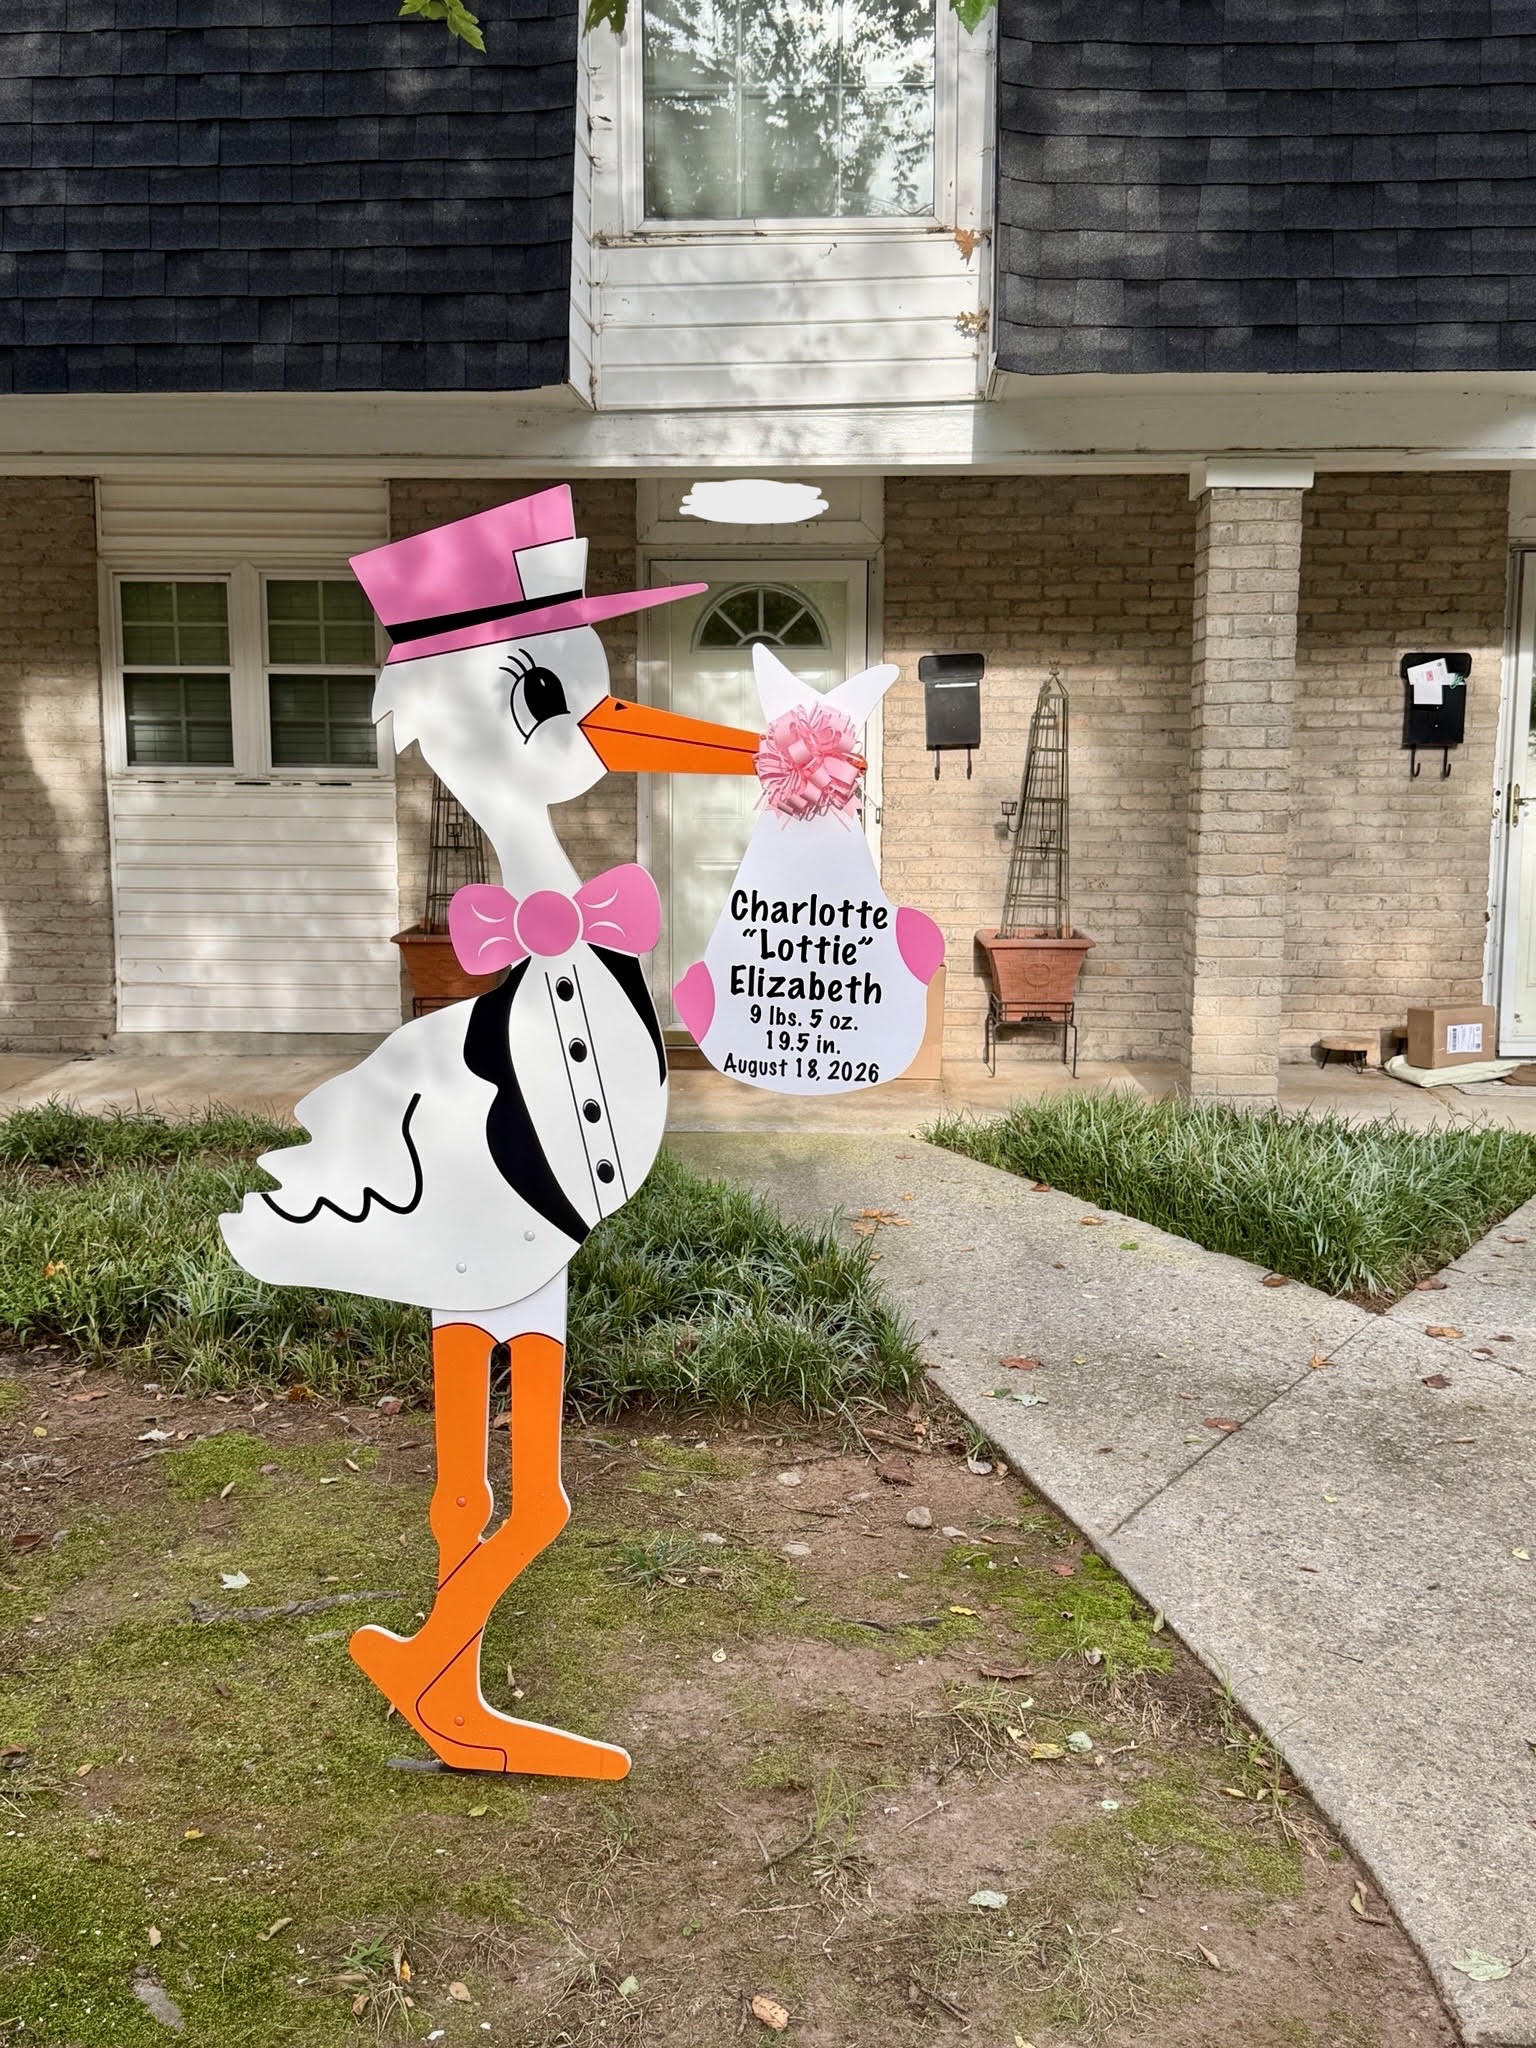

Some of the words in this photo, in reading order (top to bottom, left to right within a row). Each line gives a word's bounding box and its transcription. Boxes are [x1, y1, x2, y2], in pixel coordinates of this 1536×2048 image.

[730, 889, 888, 930] Charlotte
[730, 964, 882, 1005] Elizabeth
[749, 1003, 762, 1024] 9
[769, 1005, 802, 1027] lbs.
[809, 1008, 824, 1029] 5
[829, 1014, 858, 1031] oz.
[766, 1029, 811, 1053] 19.5
[816, 1034, 841, 1055] in.
[723, 1052, 789, 1079] August
[795, 1057, 821, 1082] 18,
[827, 1059, 880, 1084] 2026
